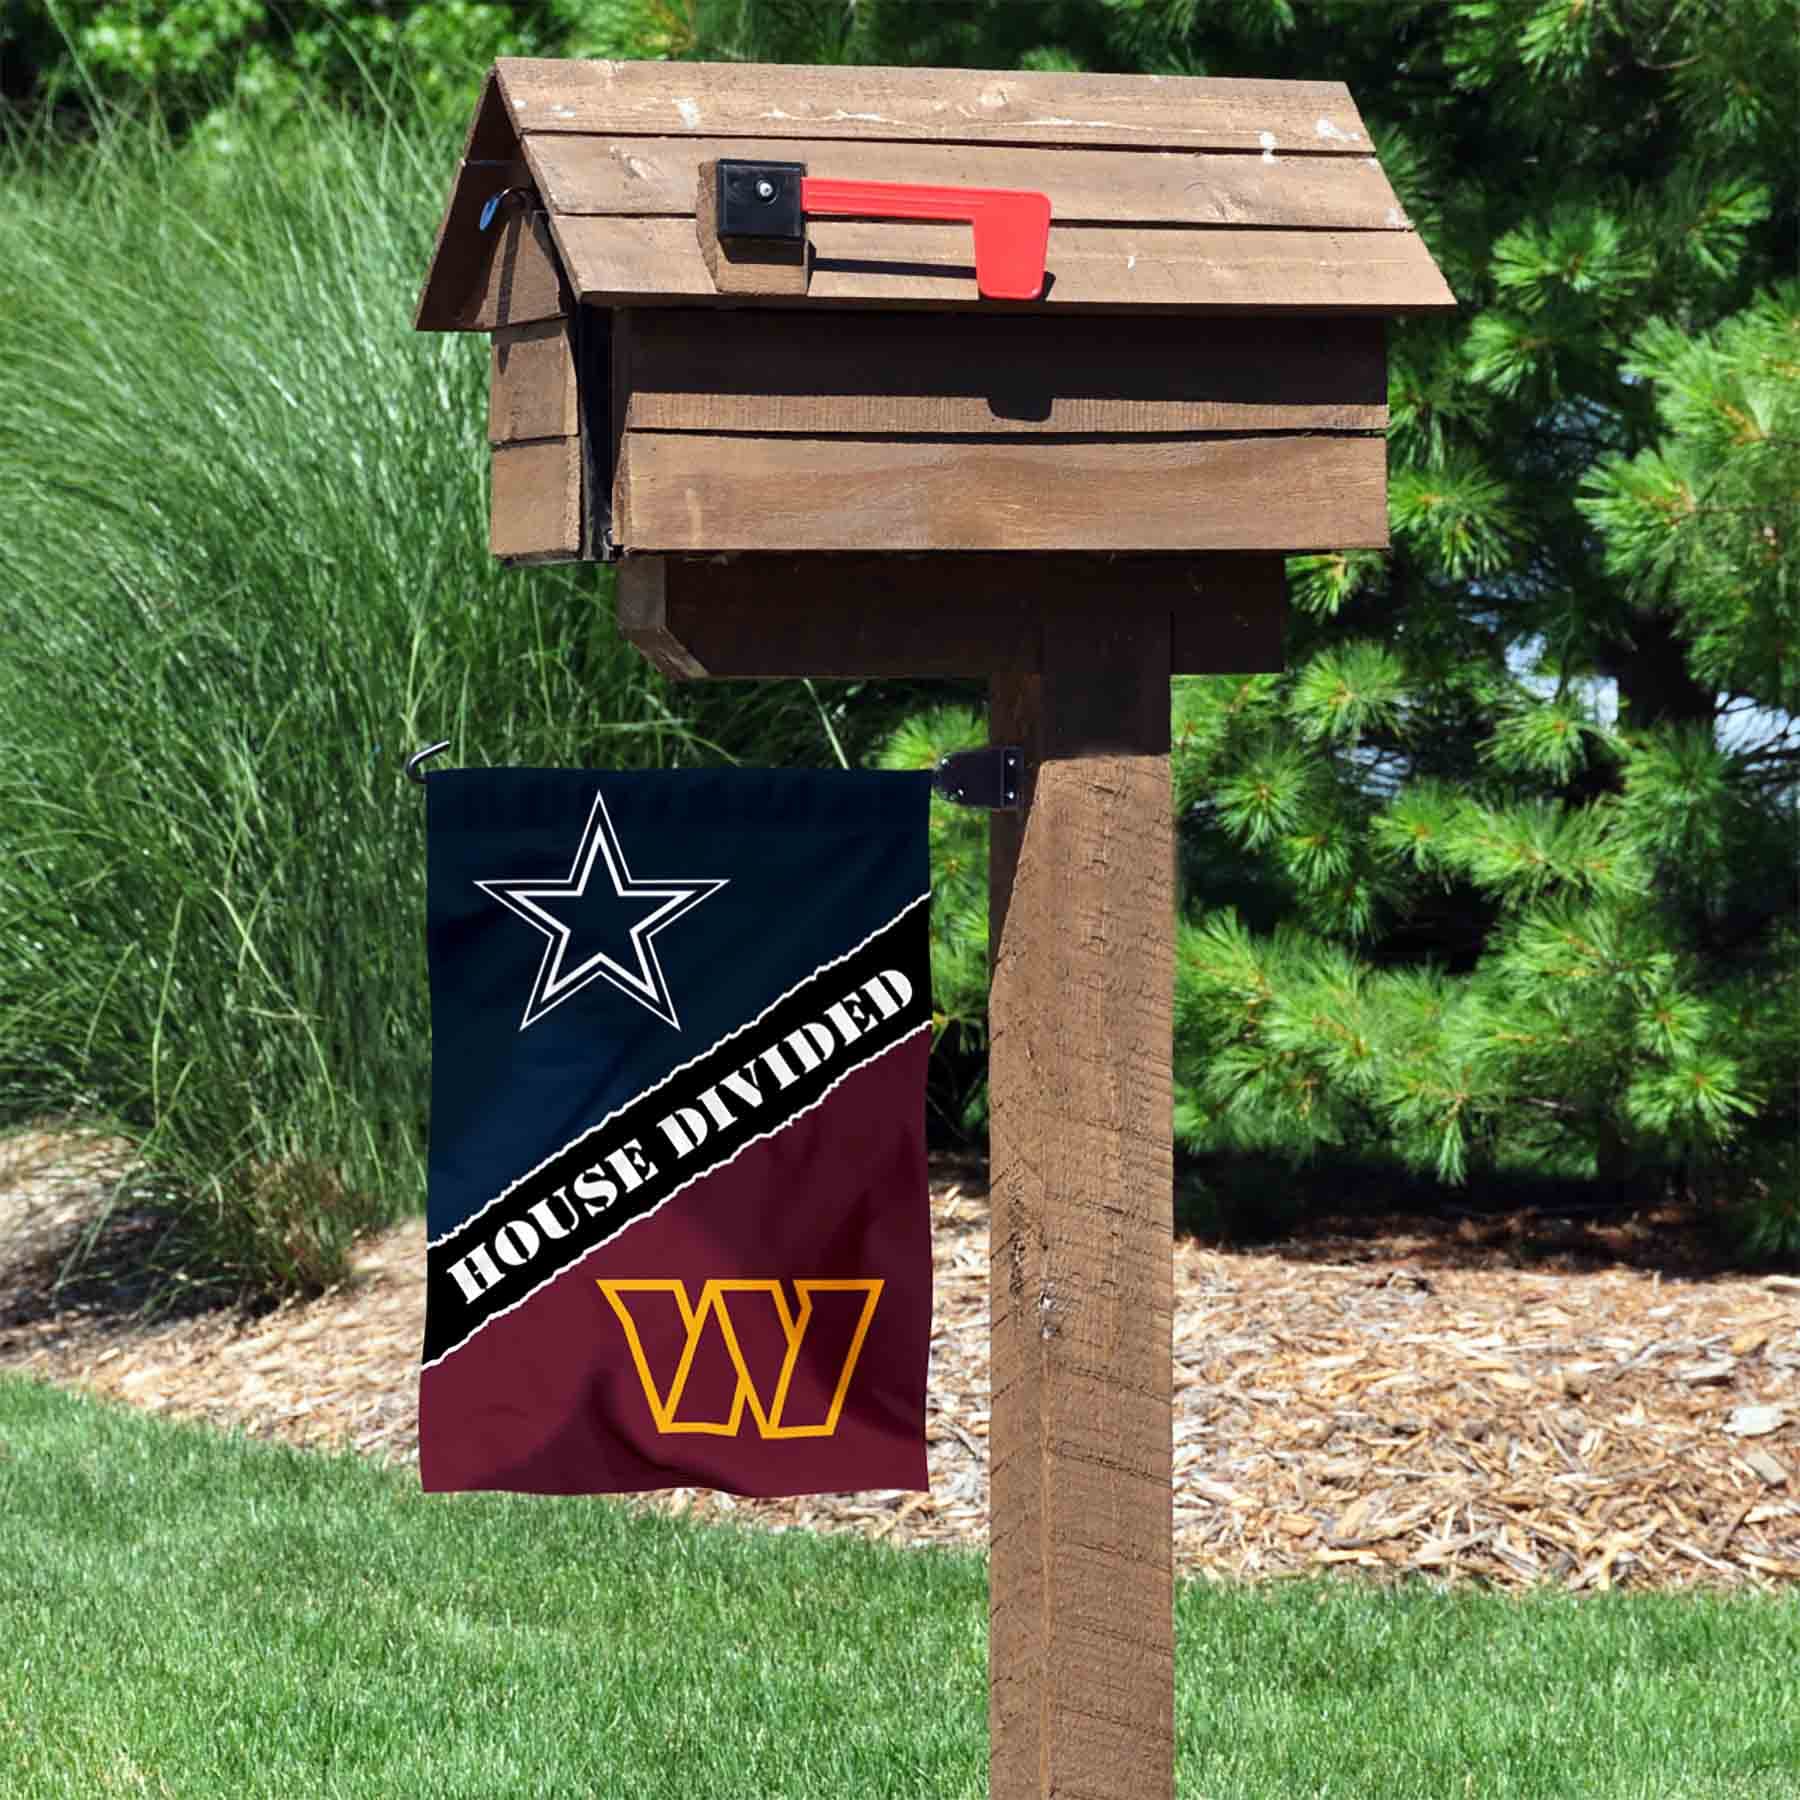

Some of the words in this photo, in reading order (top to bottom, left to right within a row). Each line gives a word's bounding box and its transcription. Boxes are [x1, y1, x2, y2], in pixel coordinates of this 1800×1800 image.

[446, 1140, 657, 1304] HOUSE
[657, 969, 914, 1158] DIVIDED
[596, 1279, 885, 1439] W
